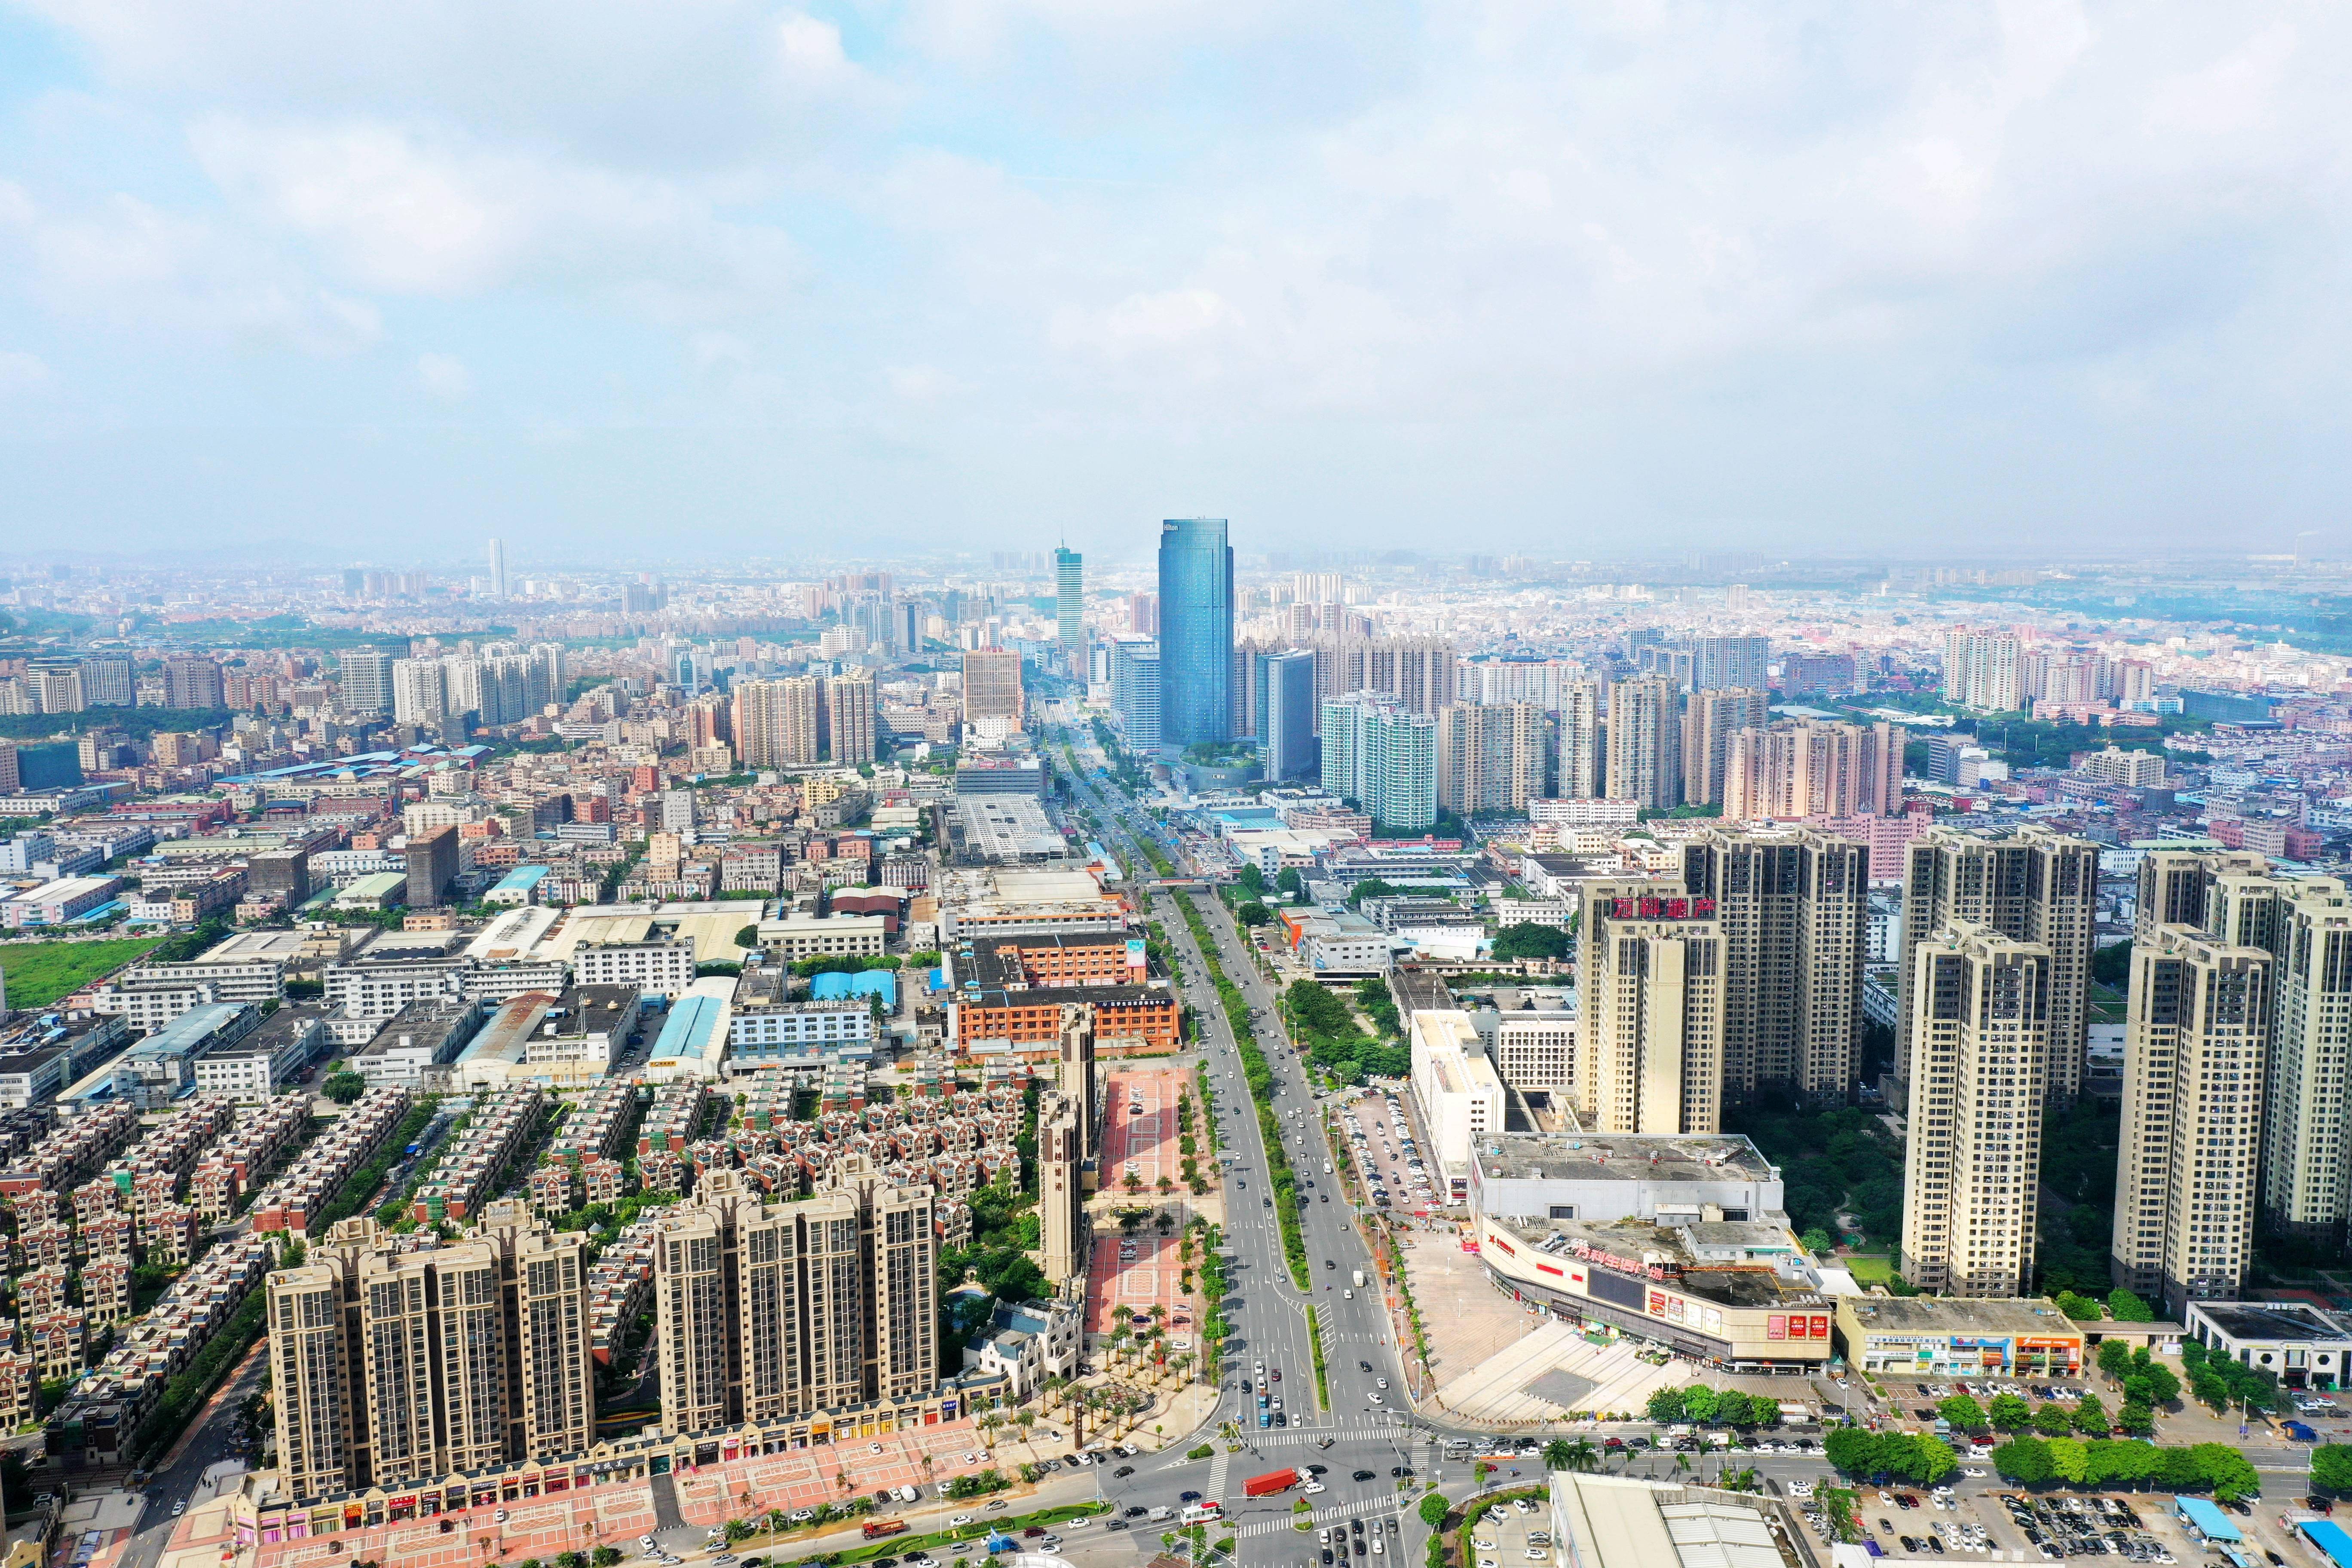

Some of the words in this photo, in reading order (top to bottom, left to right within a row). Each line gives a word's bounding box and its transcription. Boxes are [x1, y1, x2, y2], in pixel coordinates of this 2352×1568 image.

[1613, 897, 1716, 919] 万科地产
[1572, 1246, 1664, 1281] 万科生活广场
